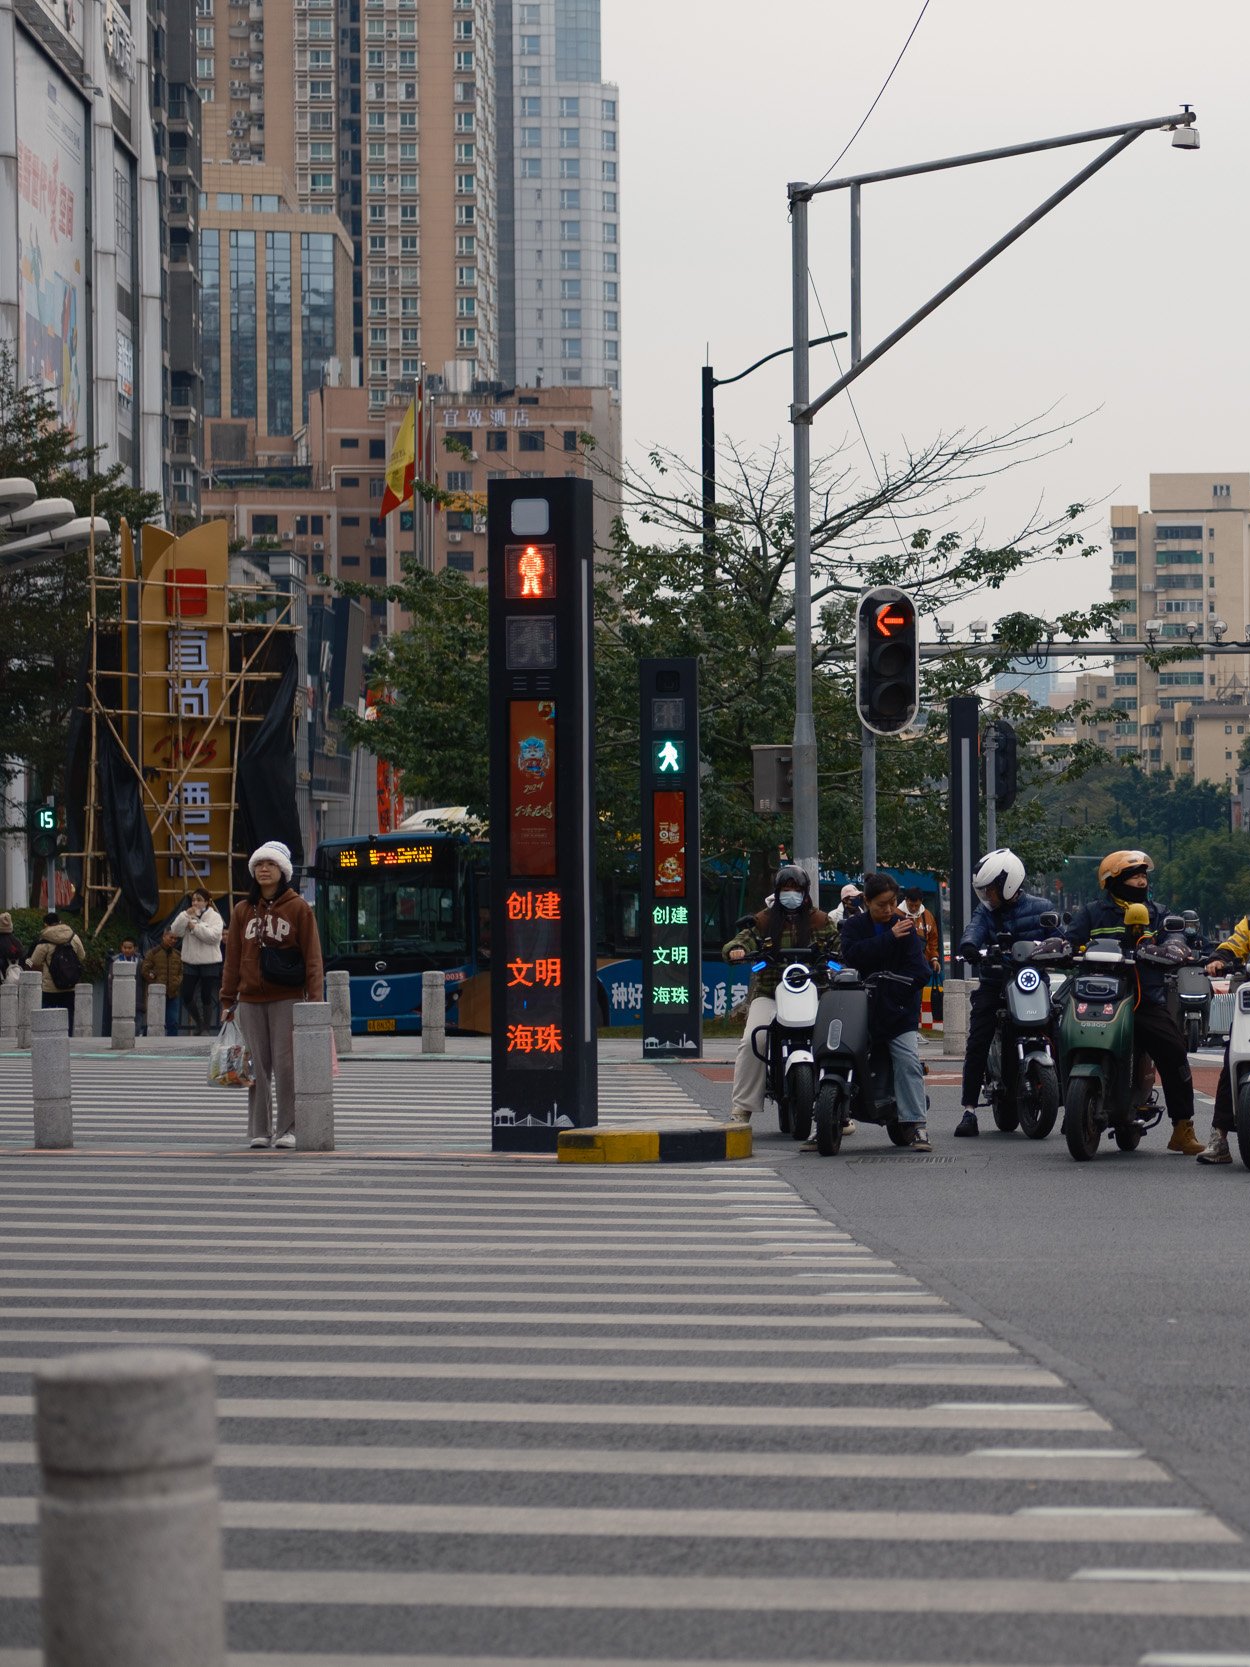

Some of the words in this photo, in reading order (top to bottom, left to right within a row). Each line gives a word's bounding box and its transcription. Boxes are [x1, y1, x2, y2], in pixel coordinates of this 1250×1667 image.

[40, 811, 54, 829] 15
[506, 891, 561, 921] 创建
[652, 905, 689, 925] 创建
[245, 914, 290, 942] GAP
[652, 946, 689, 965] 文明
[506, 957, 561, 987] 文明
[652, 985, 689, 1005] 海珠
[506, 1023, 562, 1053] 海珠
